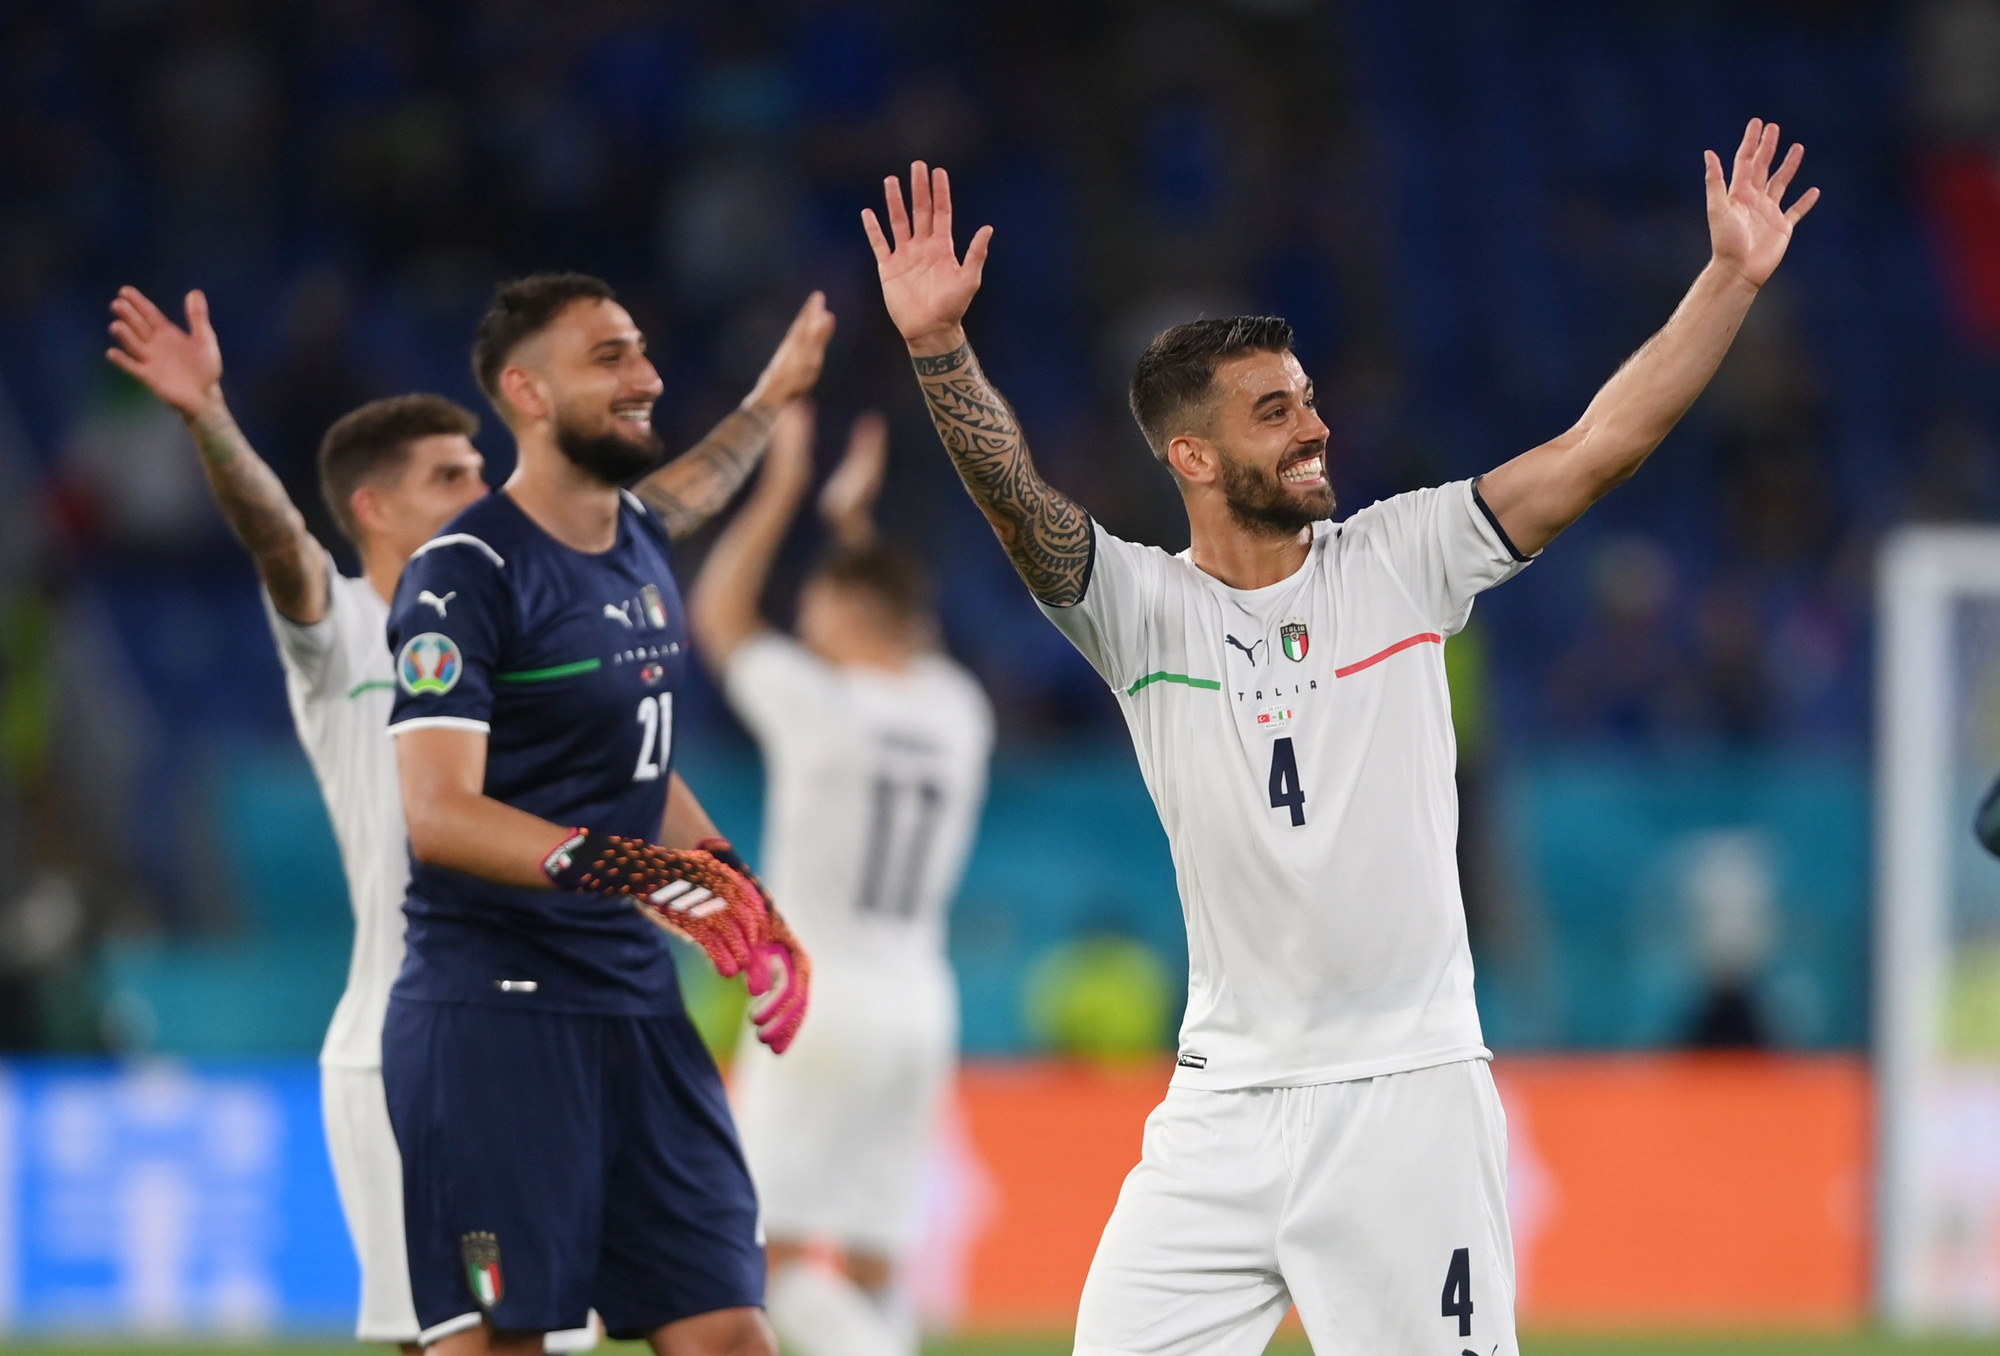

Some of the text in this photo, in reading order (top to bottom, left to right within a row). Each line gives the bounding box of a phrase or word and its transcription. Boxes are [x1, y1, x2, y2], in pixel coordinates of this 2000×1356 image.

[1281, 625, 1306, 634] ITALIA
[1238, 680, 1317, 701] TALIA
[632, 691, 673, 781] 21
[1268, 737, 1306, 827] 4
[1441, 1247, 1474, 1337] 4
